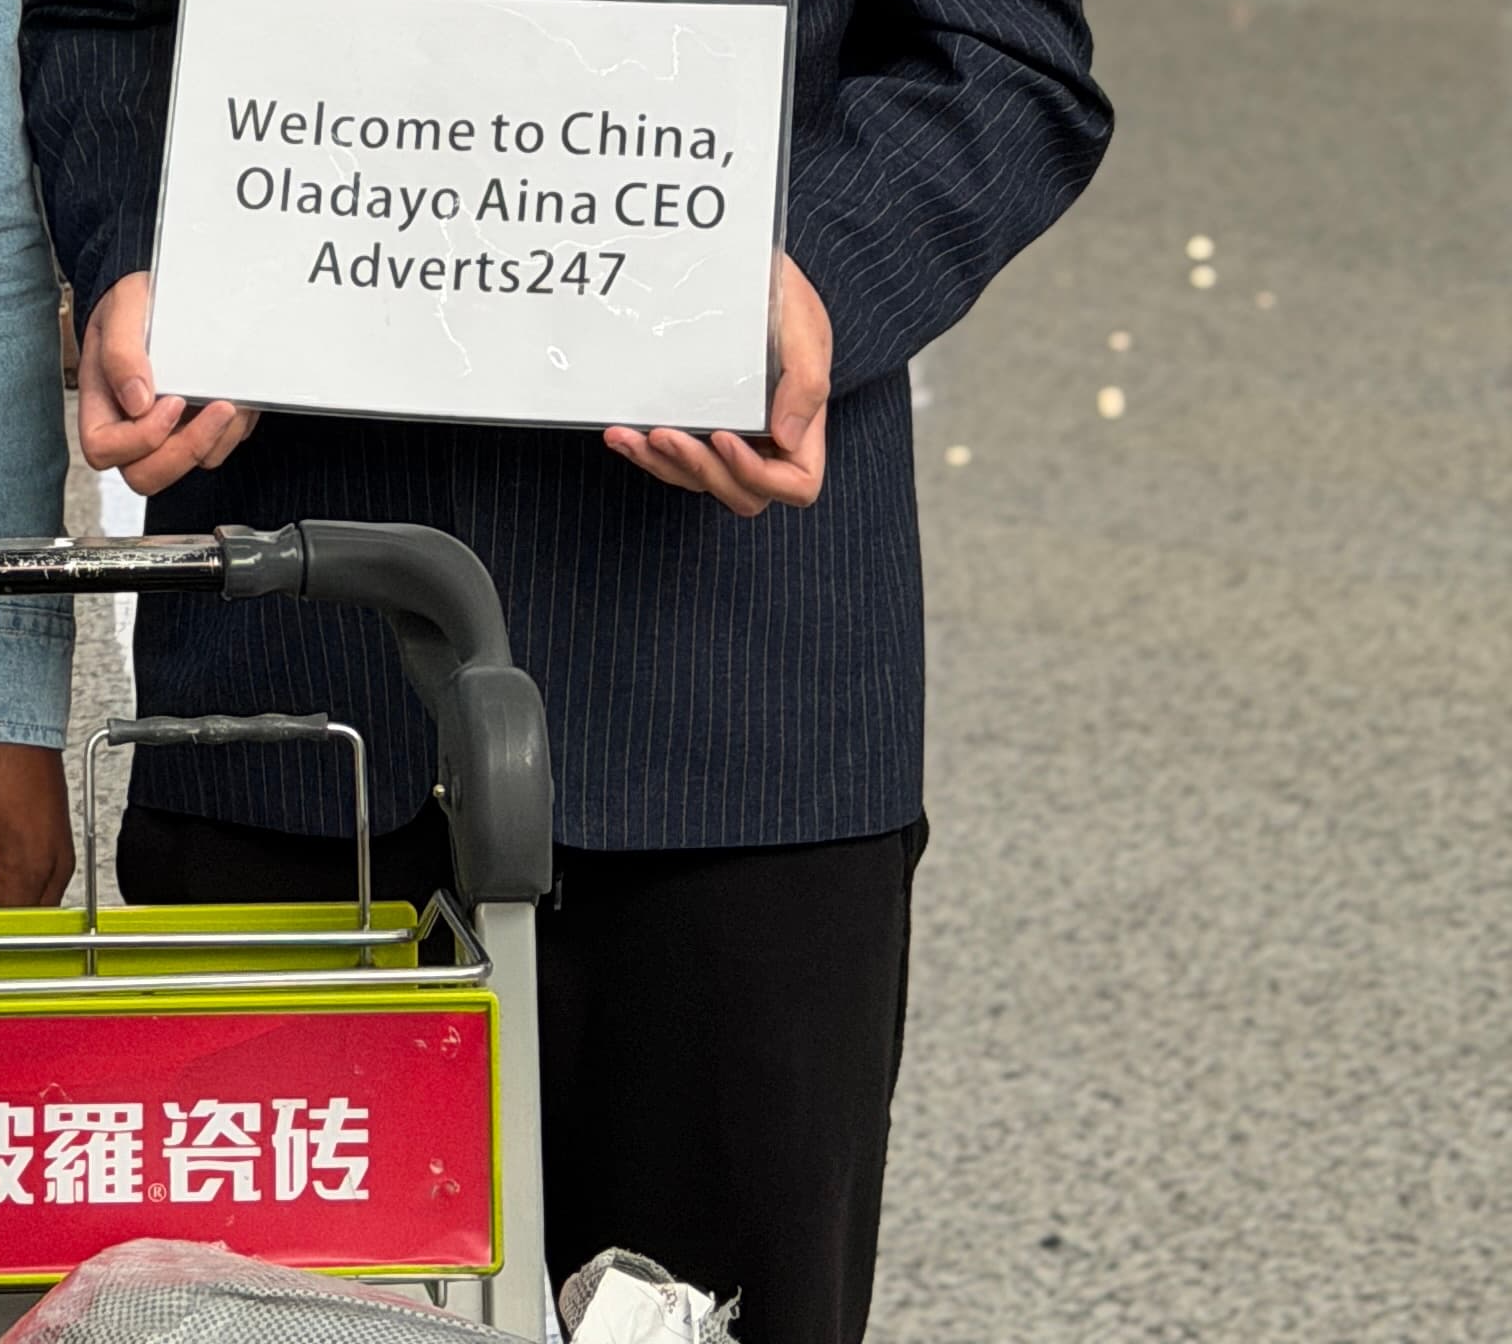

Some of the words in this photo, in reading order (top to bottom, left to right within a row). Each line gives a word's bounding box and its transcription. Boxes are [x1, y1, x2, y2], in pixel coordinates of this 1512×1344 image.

[226, 96, 476, 153] Welcome
[490, 113, 545, 155] to
[560, 109, 734, 169] China,
[235, 165, 461, 232] Oladayo
[474, 177, 597, 226] Aina
[614, 181, 726, 230] CEO
[307, 240, 627, 297] Adverts247
